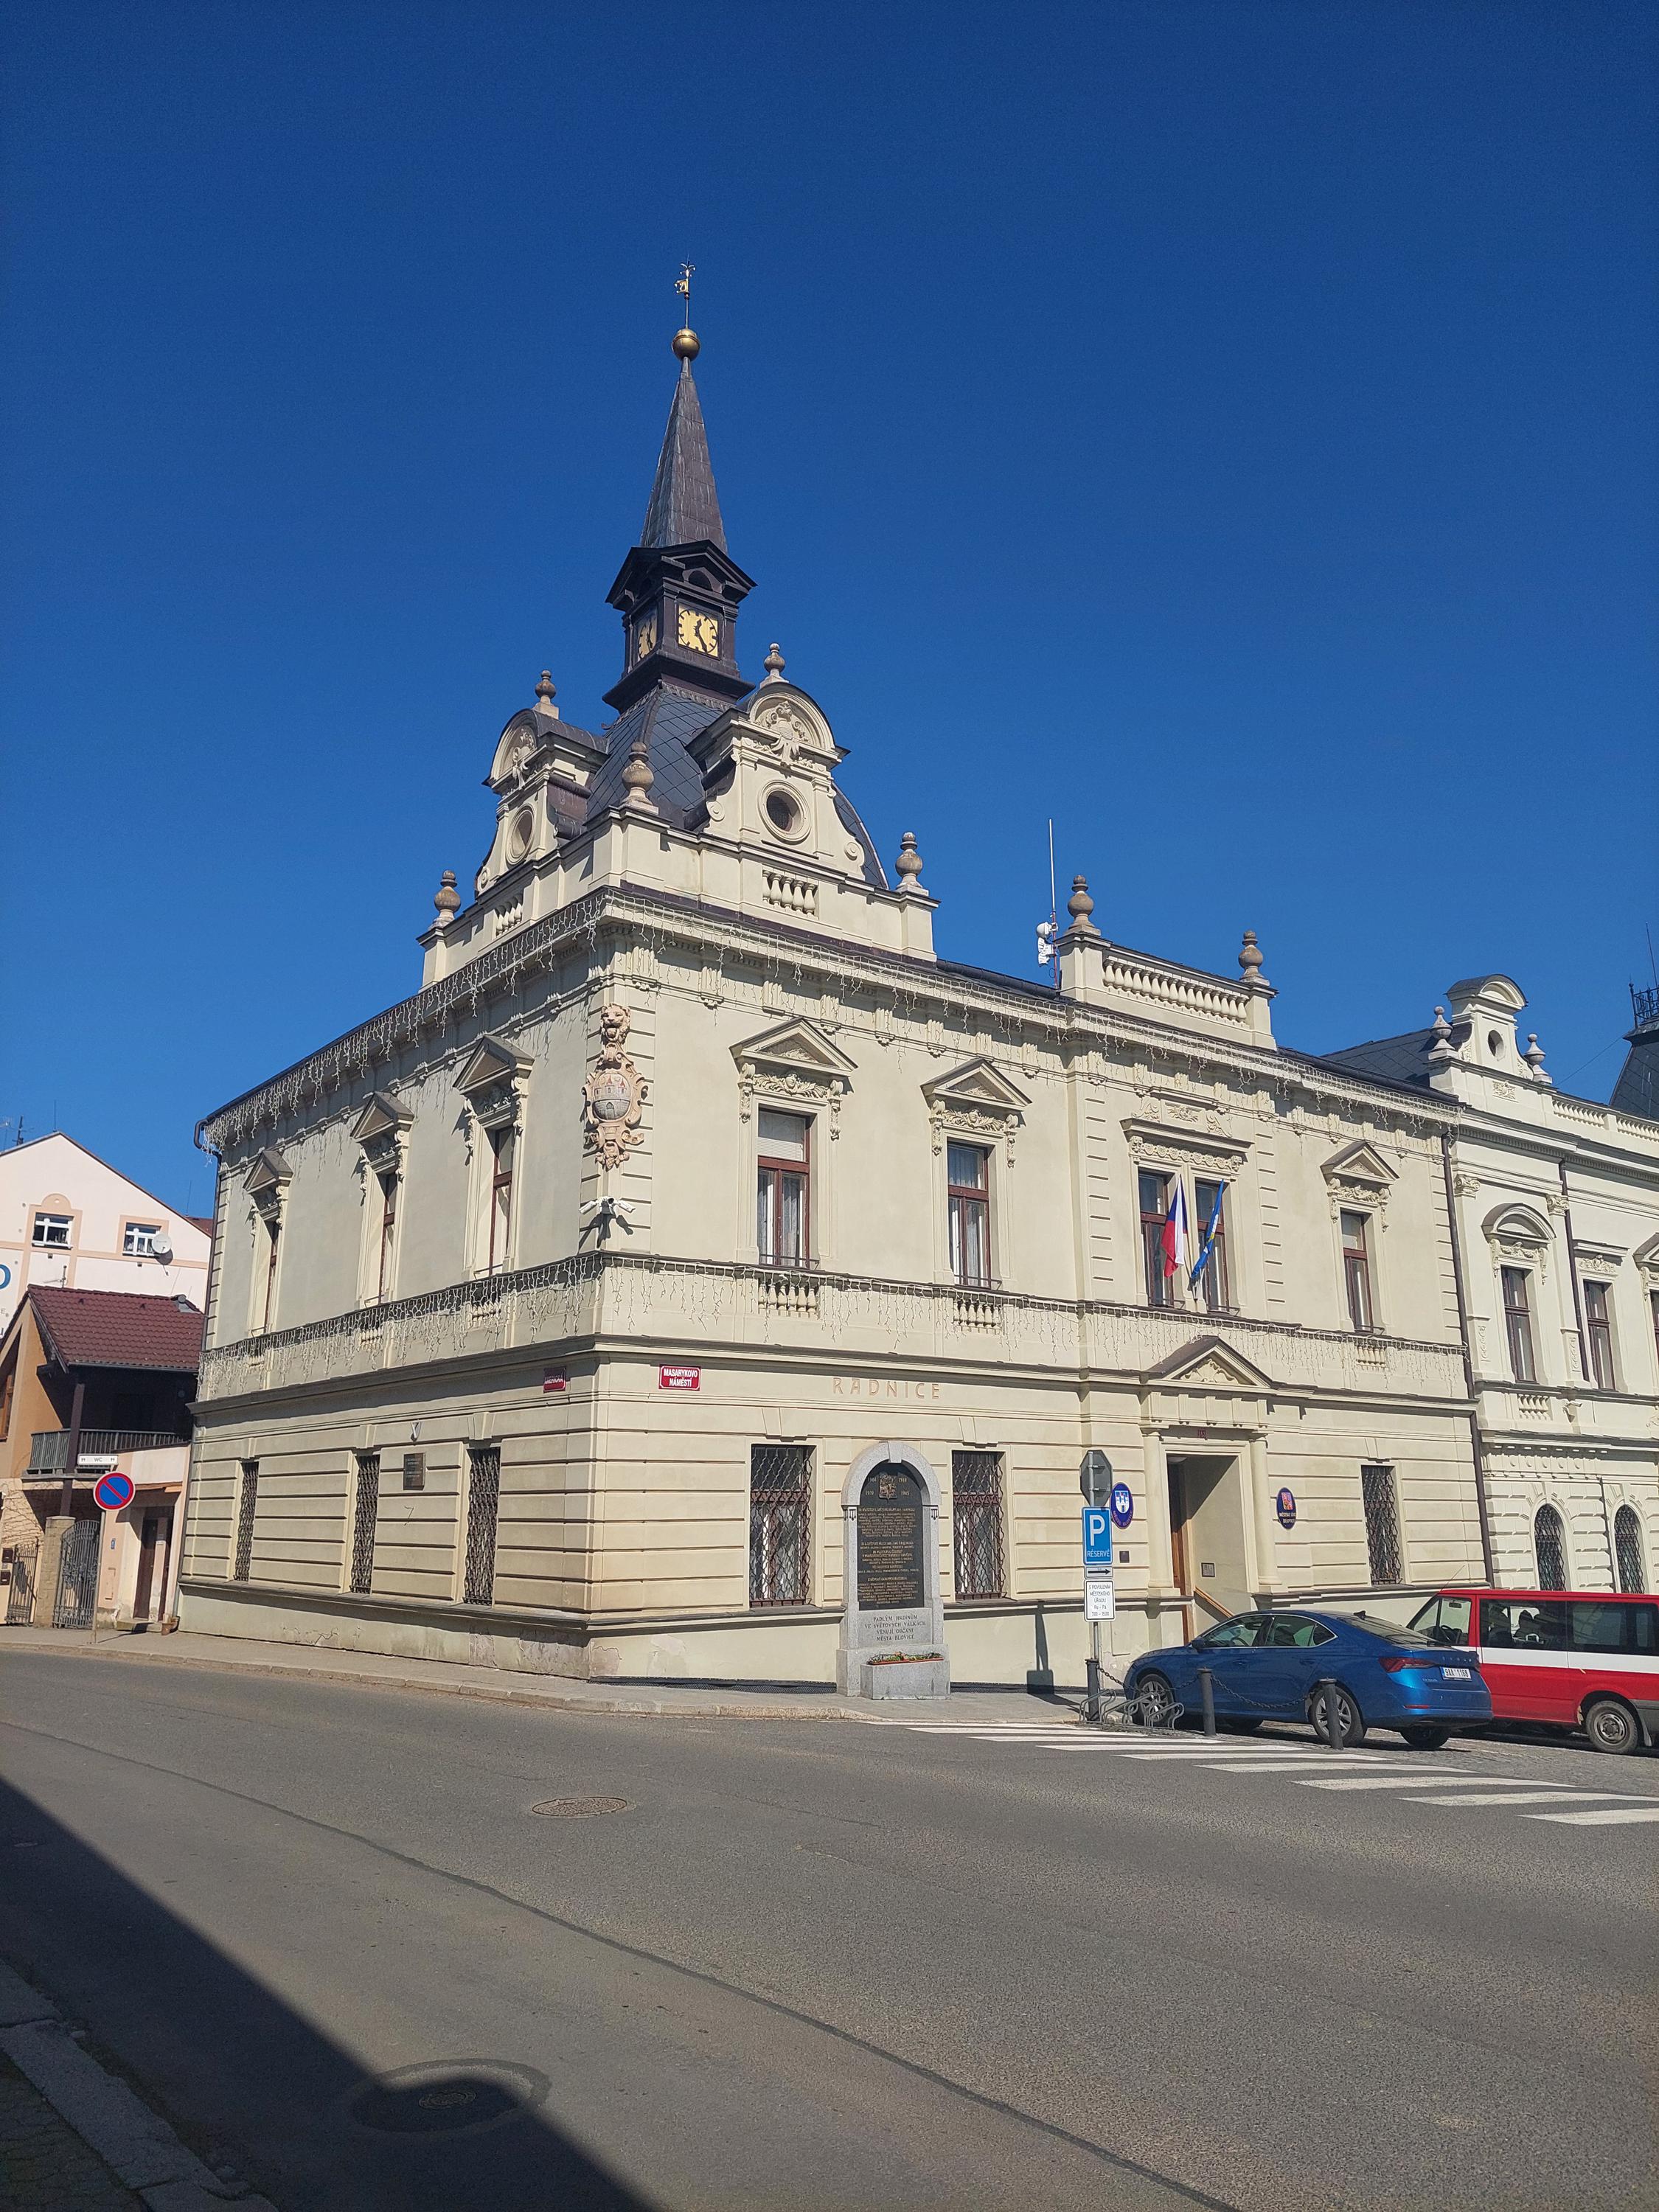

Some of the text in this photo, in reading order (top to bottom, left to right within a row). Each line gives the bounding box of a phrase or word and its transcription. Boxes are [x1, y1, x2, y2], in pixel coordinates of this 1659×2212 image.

[664, 1368, 698, 1378] MASARYKOVO
[669, 1377, 692, 1387] NÁMĚSTÍ
[832, 1377, 940, 1399] RADNICE
[1089, 1514, 1105, 1546] P
[1087, 1548, 1110, 1557] RÉSERVÉ
